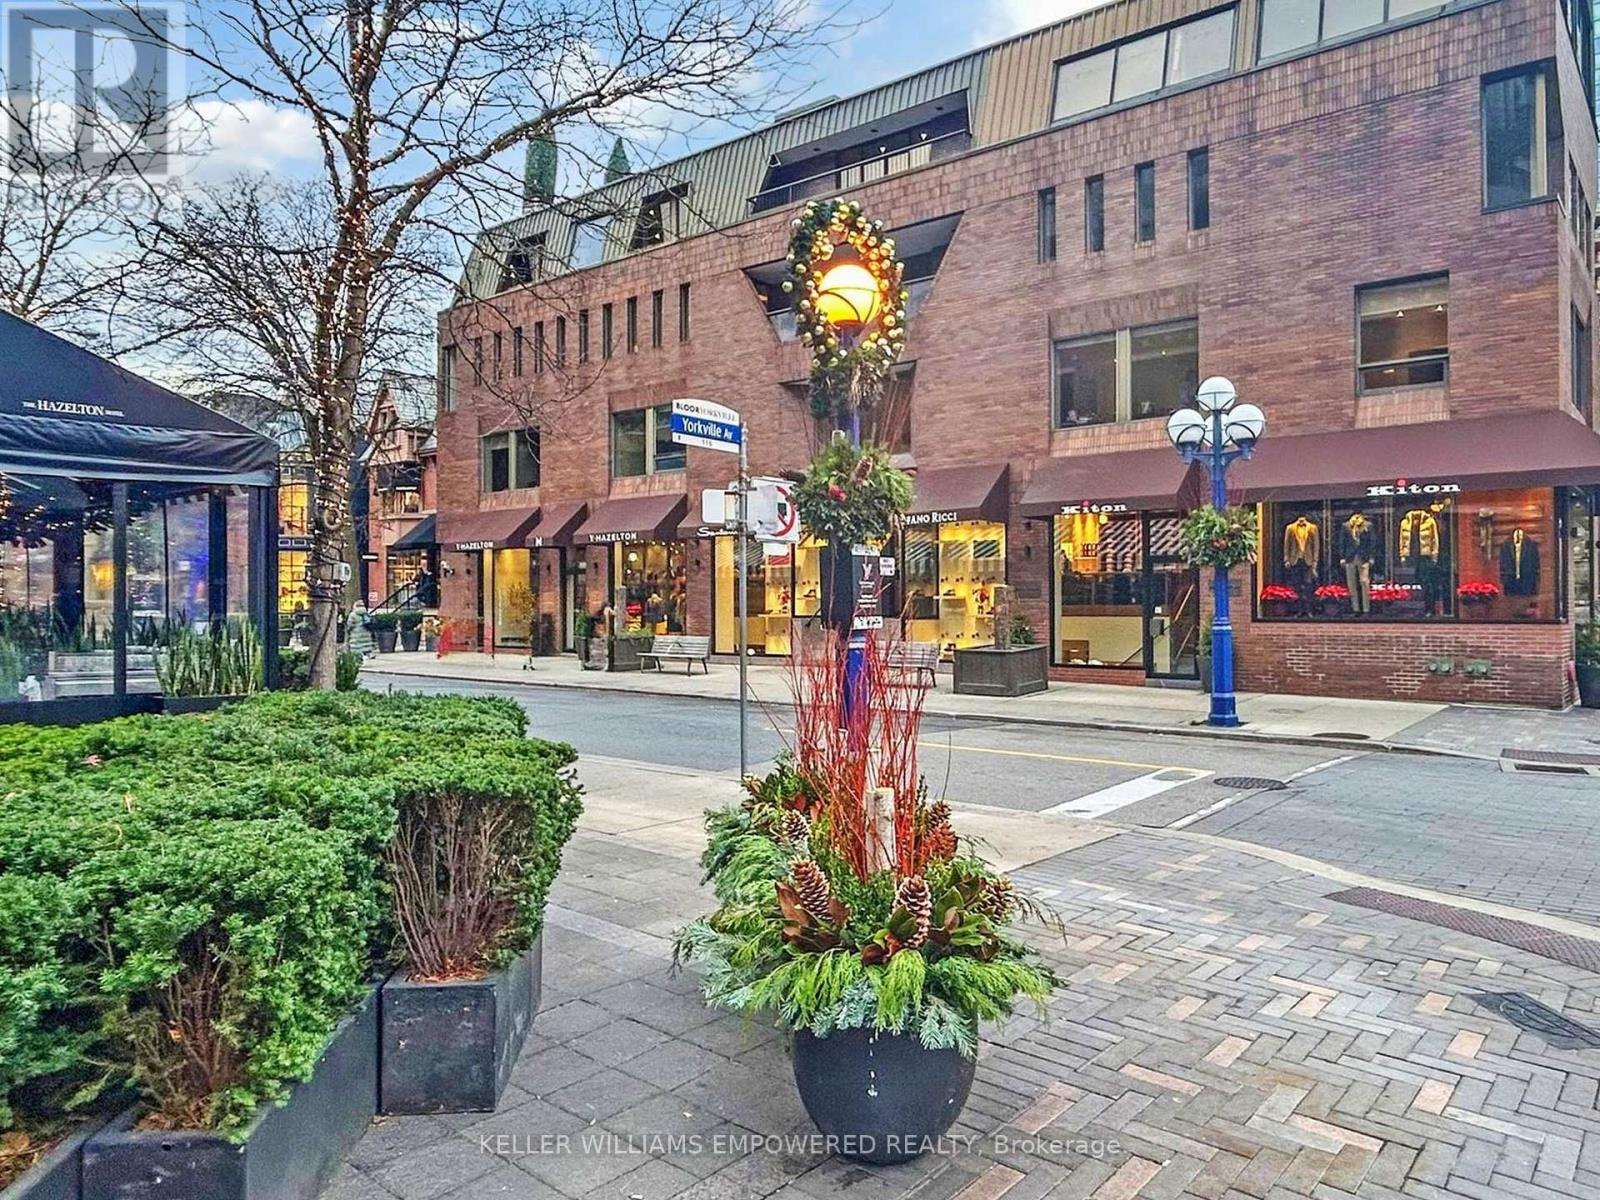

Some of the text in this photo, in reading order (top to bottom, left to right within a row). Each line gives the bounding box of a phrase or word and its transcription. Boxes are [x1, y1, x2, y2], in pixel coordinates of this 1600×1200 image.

[37, 400, 105, 416] HAZELTON
[682, 417, 722, 438] Yorkville
[1366, 479, 1461, 497] Kiton
[1060, 500, 1128, 516] Kiton
[1371, 582, 1423, 591] Kiton
